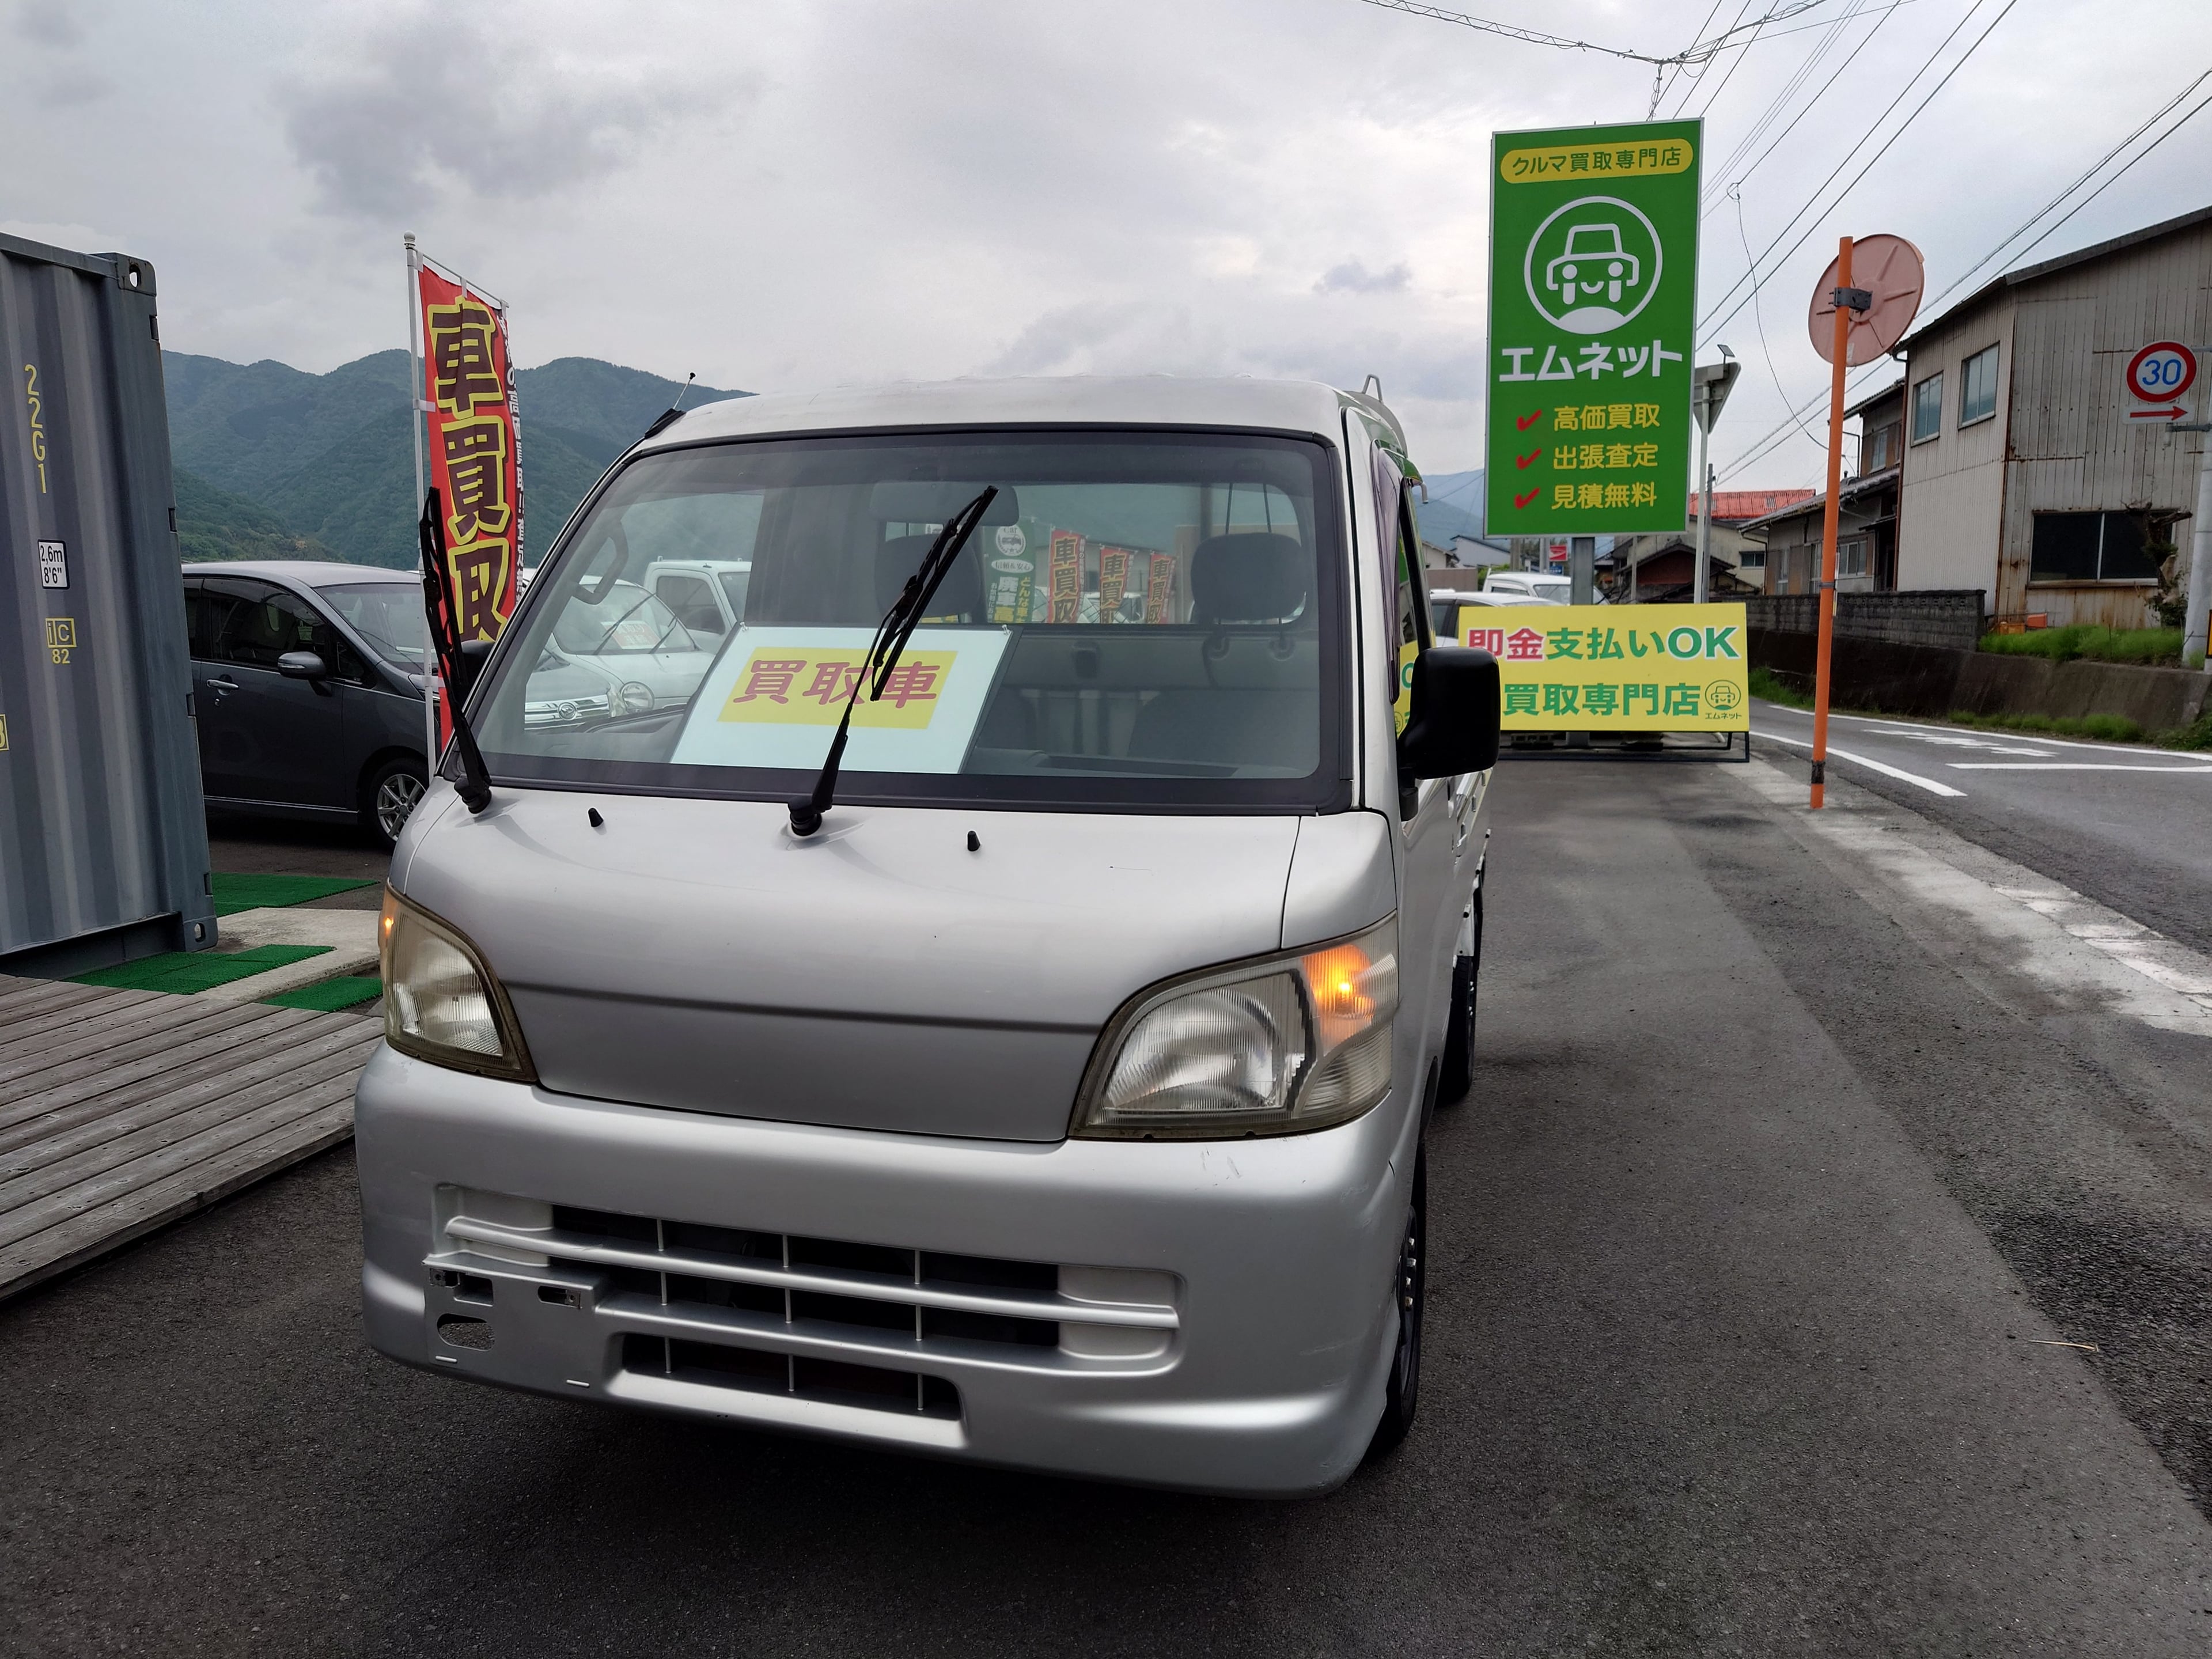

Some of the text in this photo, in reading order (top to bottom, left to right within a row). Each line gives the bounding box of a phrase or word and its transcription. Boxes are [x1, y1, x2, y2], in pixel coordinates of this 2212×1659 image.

[1513, 147, 1681, 176] クルマ買取専門店
[1499, 339, 1683, 382] エムネット
[2142, 359, 2182, 385] 30
[25, 364, 46, 494] 22G1
[1554, 404, 1661, 431] 高価買取
[1553, 444, 1659, 470] 出張査定
[1551, 482, 1657, 510] 見積無料
[40, 545, 63, 565] 2,6m
[52, 648, 71, 664] 82
[1468, 626, 1739, 660] 即金支払いOK
[733, 659, 941, 709] 買取車
[1503, 683, 1701, 716] 買取専門店
